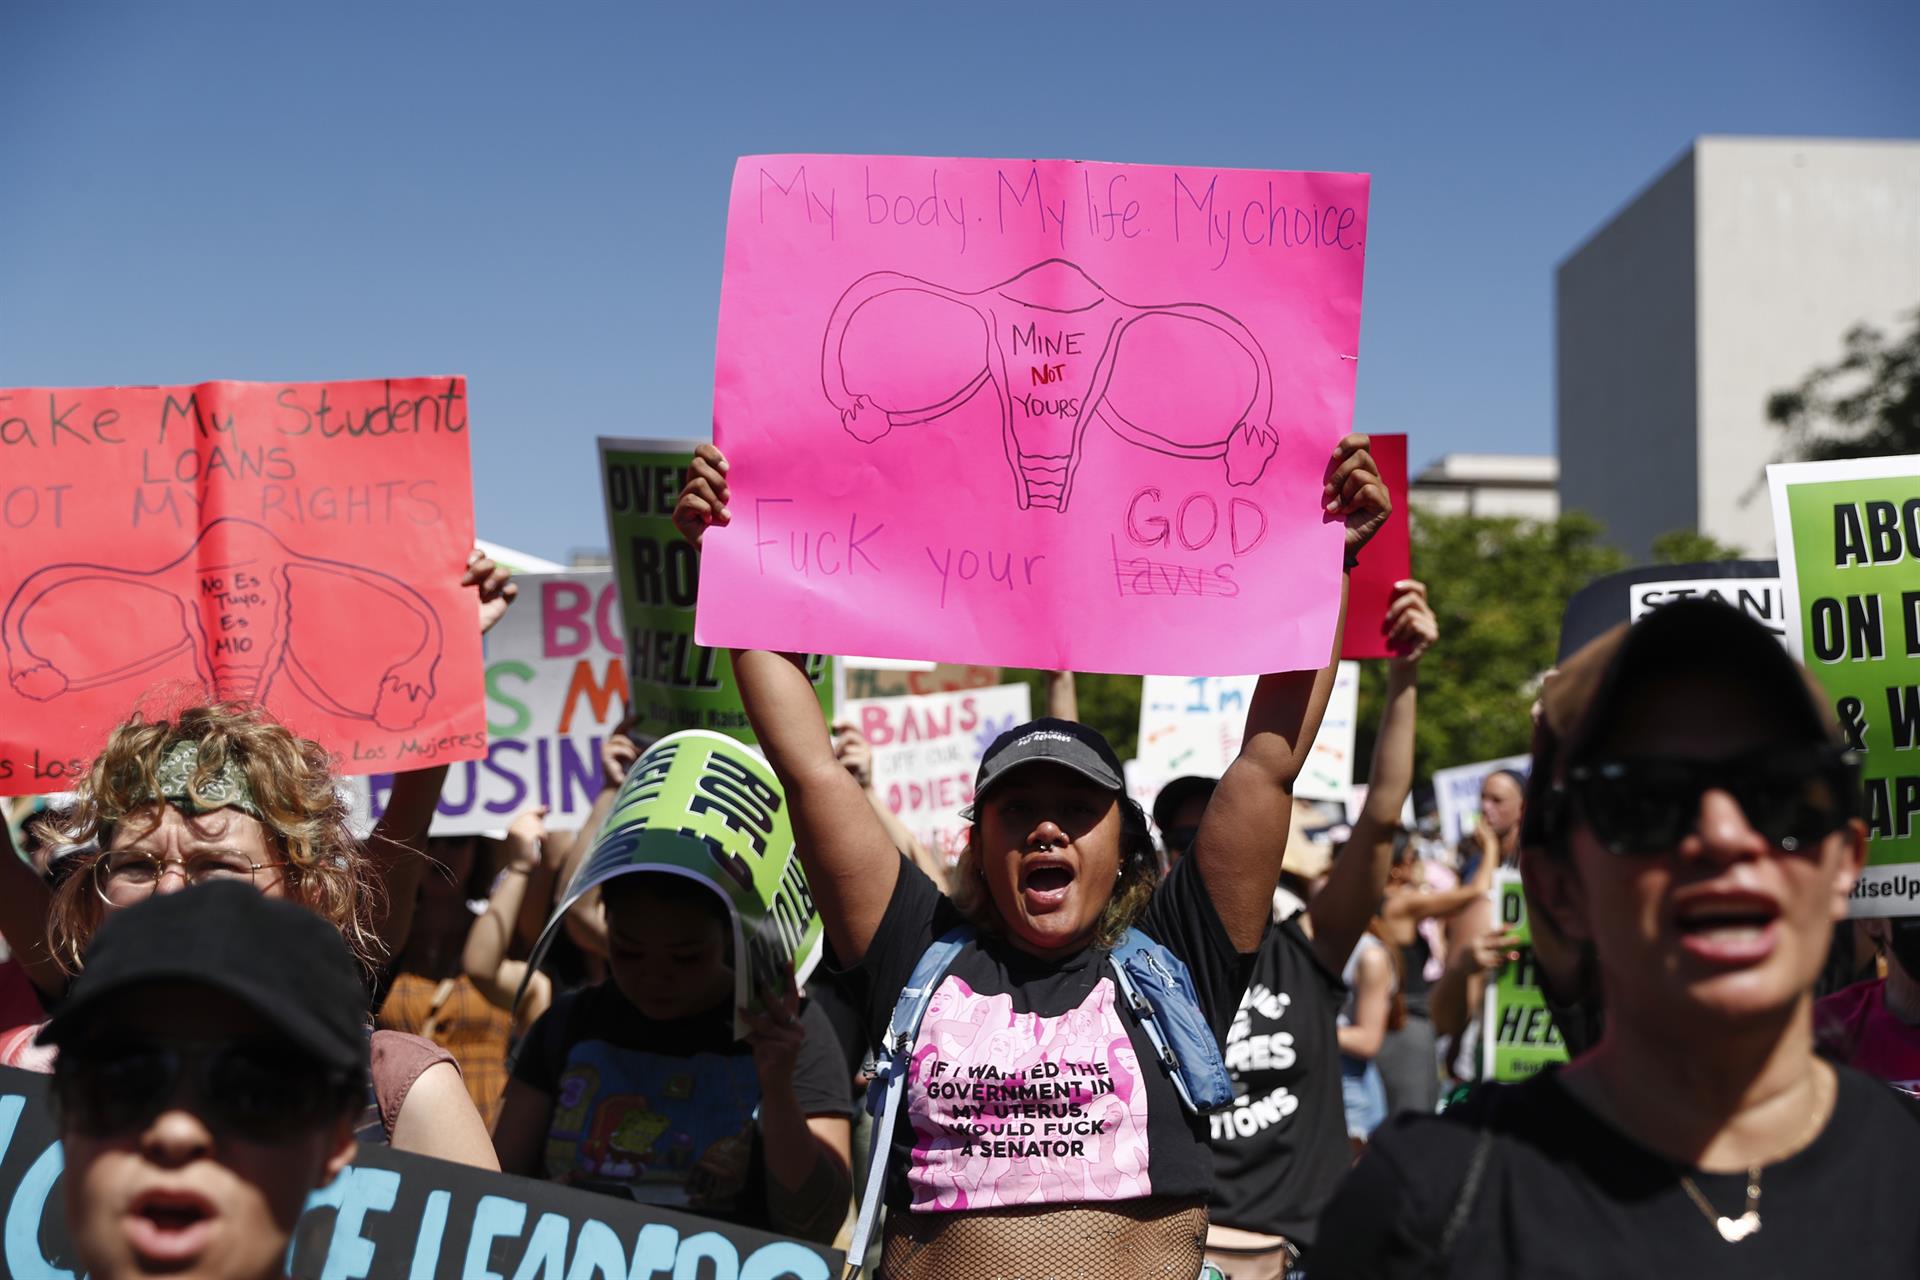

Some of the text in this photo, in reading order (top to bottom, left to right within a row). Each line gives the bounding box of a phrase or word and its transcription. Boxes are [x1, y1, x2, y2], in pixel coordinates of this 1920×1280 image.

[760, 165, 1363, 271] My body. My life. My choice.
[1012, 321, 1085, 357] MINE
[1030, 363, 1066, 387] NOT
[0, 378, 468, 452] ake My Student
[1013, 392, 1079, 420] YOURS
[143, 445, 297, 482] LOANS
[3, 480, 442, 529] OT MY RIGHTS
[1123, 485, 1269, 558] GOD
[630, 537, 701, 609] RO
[926, 546, 1046, 609] your
[1107, 533, 1242, 599] laws
[1641, 588, 1785, 621] STAN
[1811, 591, 1886, 664] ON
[861, 698, 977, 747] BANS
[888, 773, 974, 815] ODIES
[1864, 776, 1920, 841] AP
[927, 1077, 1115, 1101] GOVERNMENT IN
[930, 1061, 948, 1078] IF
[1066, 1062, 1109, 1077] THE
[950, 1119, 1105, 1136] WOULD FUCK
[952, 1102, 1088, 1120] MY UTERUS,
[960, 1140, 1085, 1158] A SENATOR
